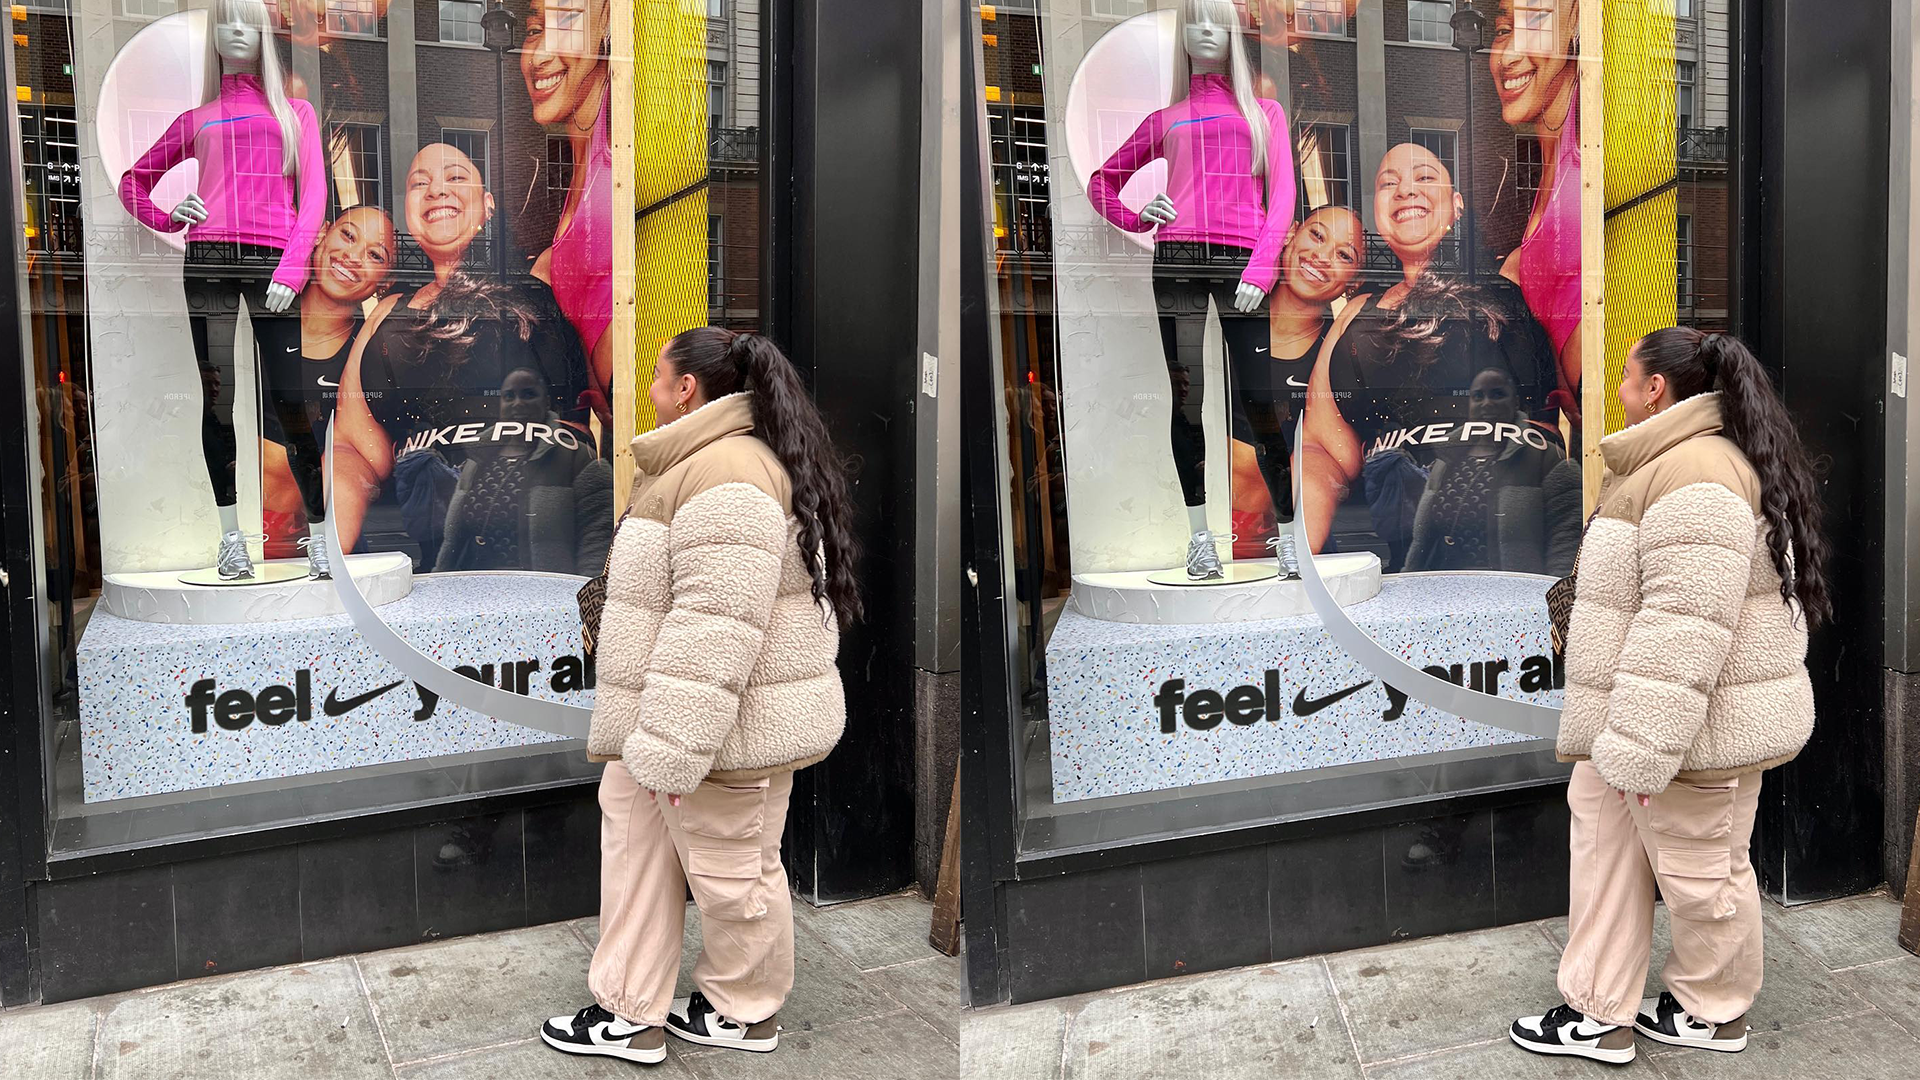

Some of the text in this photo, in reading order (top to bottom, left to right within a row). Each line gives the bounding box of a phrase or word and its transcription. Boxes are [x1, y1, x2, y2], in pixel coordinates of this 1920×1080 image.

[403, 422, 579, 456] NIKE PRO
[1372, 422, 1548, 456] NIKE PRO
[185, 669, 311, 734] feel
[1154, 669, 1280, 734] feel
